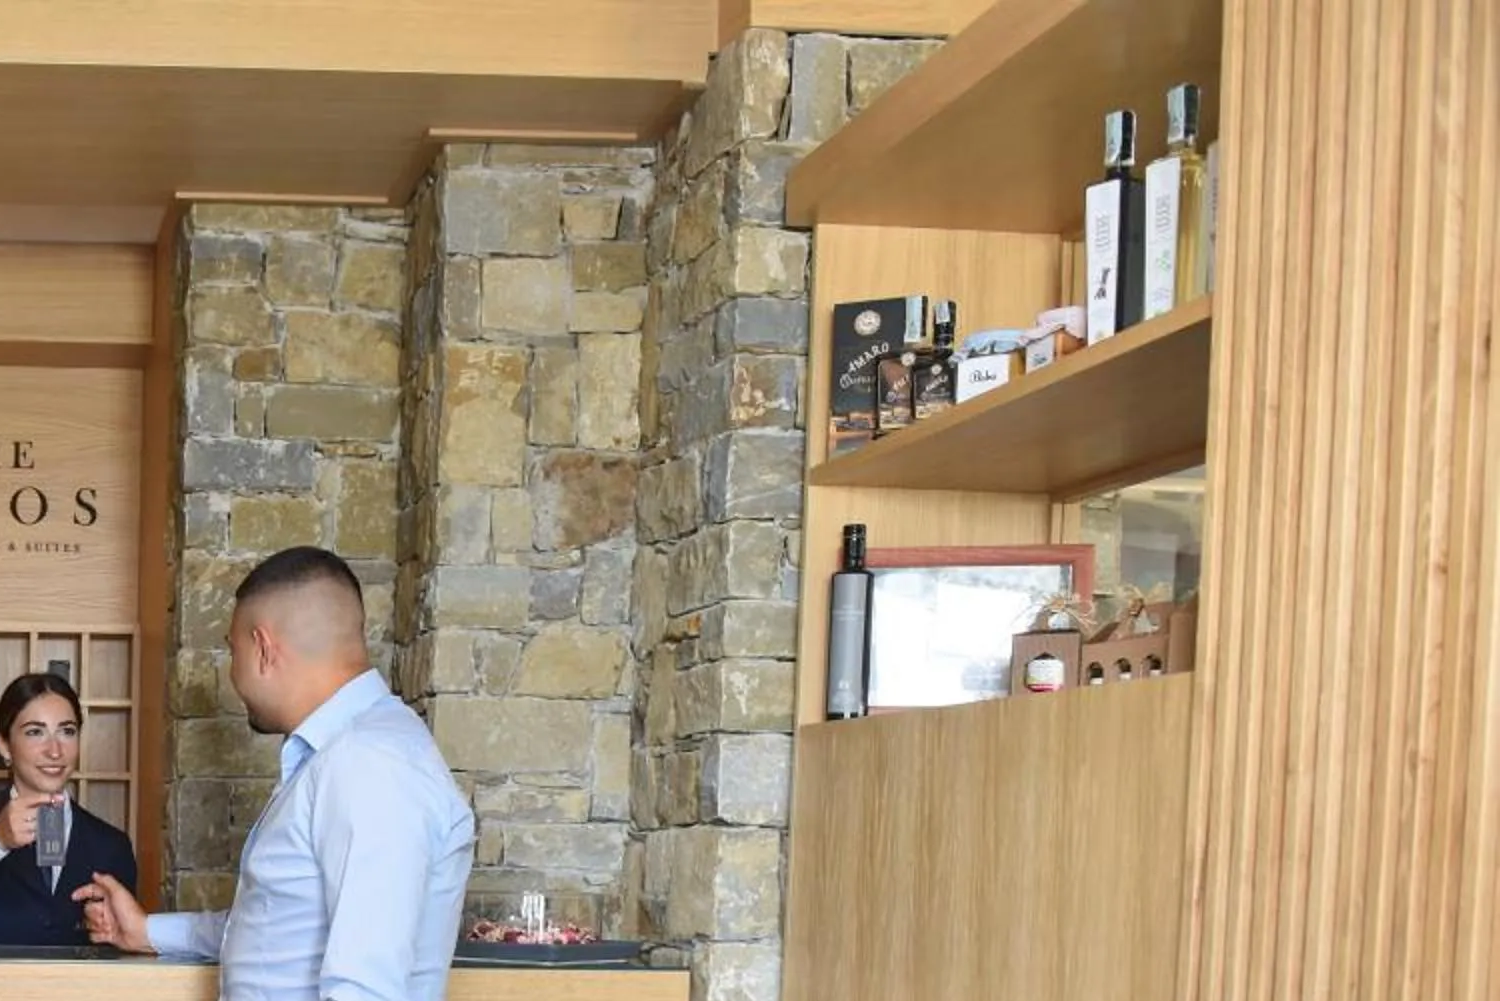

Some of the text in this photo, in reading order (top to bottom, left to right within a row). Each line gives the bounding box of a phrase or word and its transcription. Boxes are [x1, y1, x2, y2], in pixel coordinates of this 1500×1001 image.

[847, 342, 890, 374] AMARO
[7, 542, 16, 552] &
[25, 542, 81, 553] SUITES
